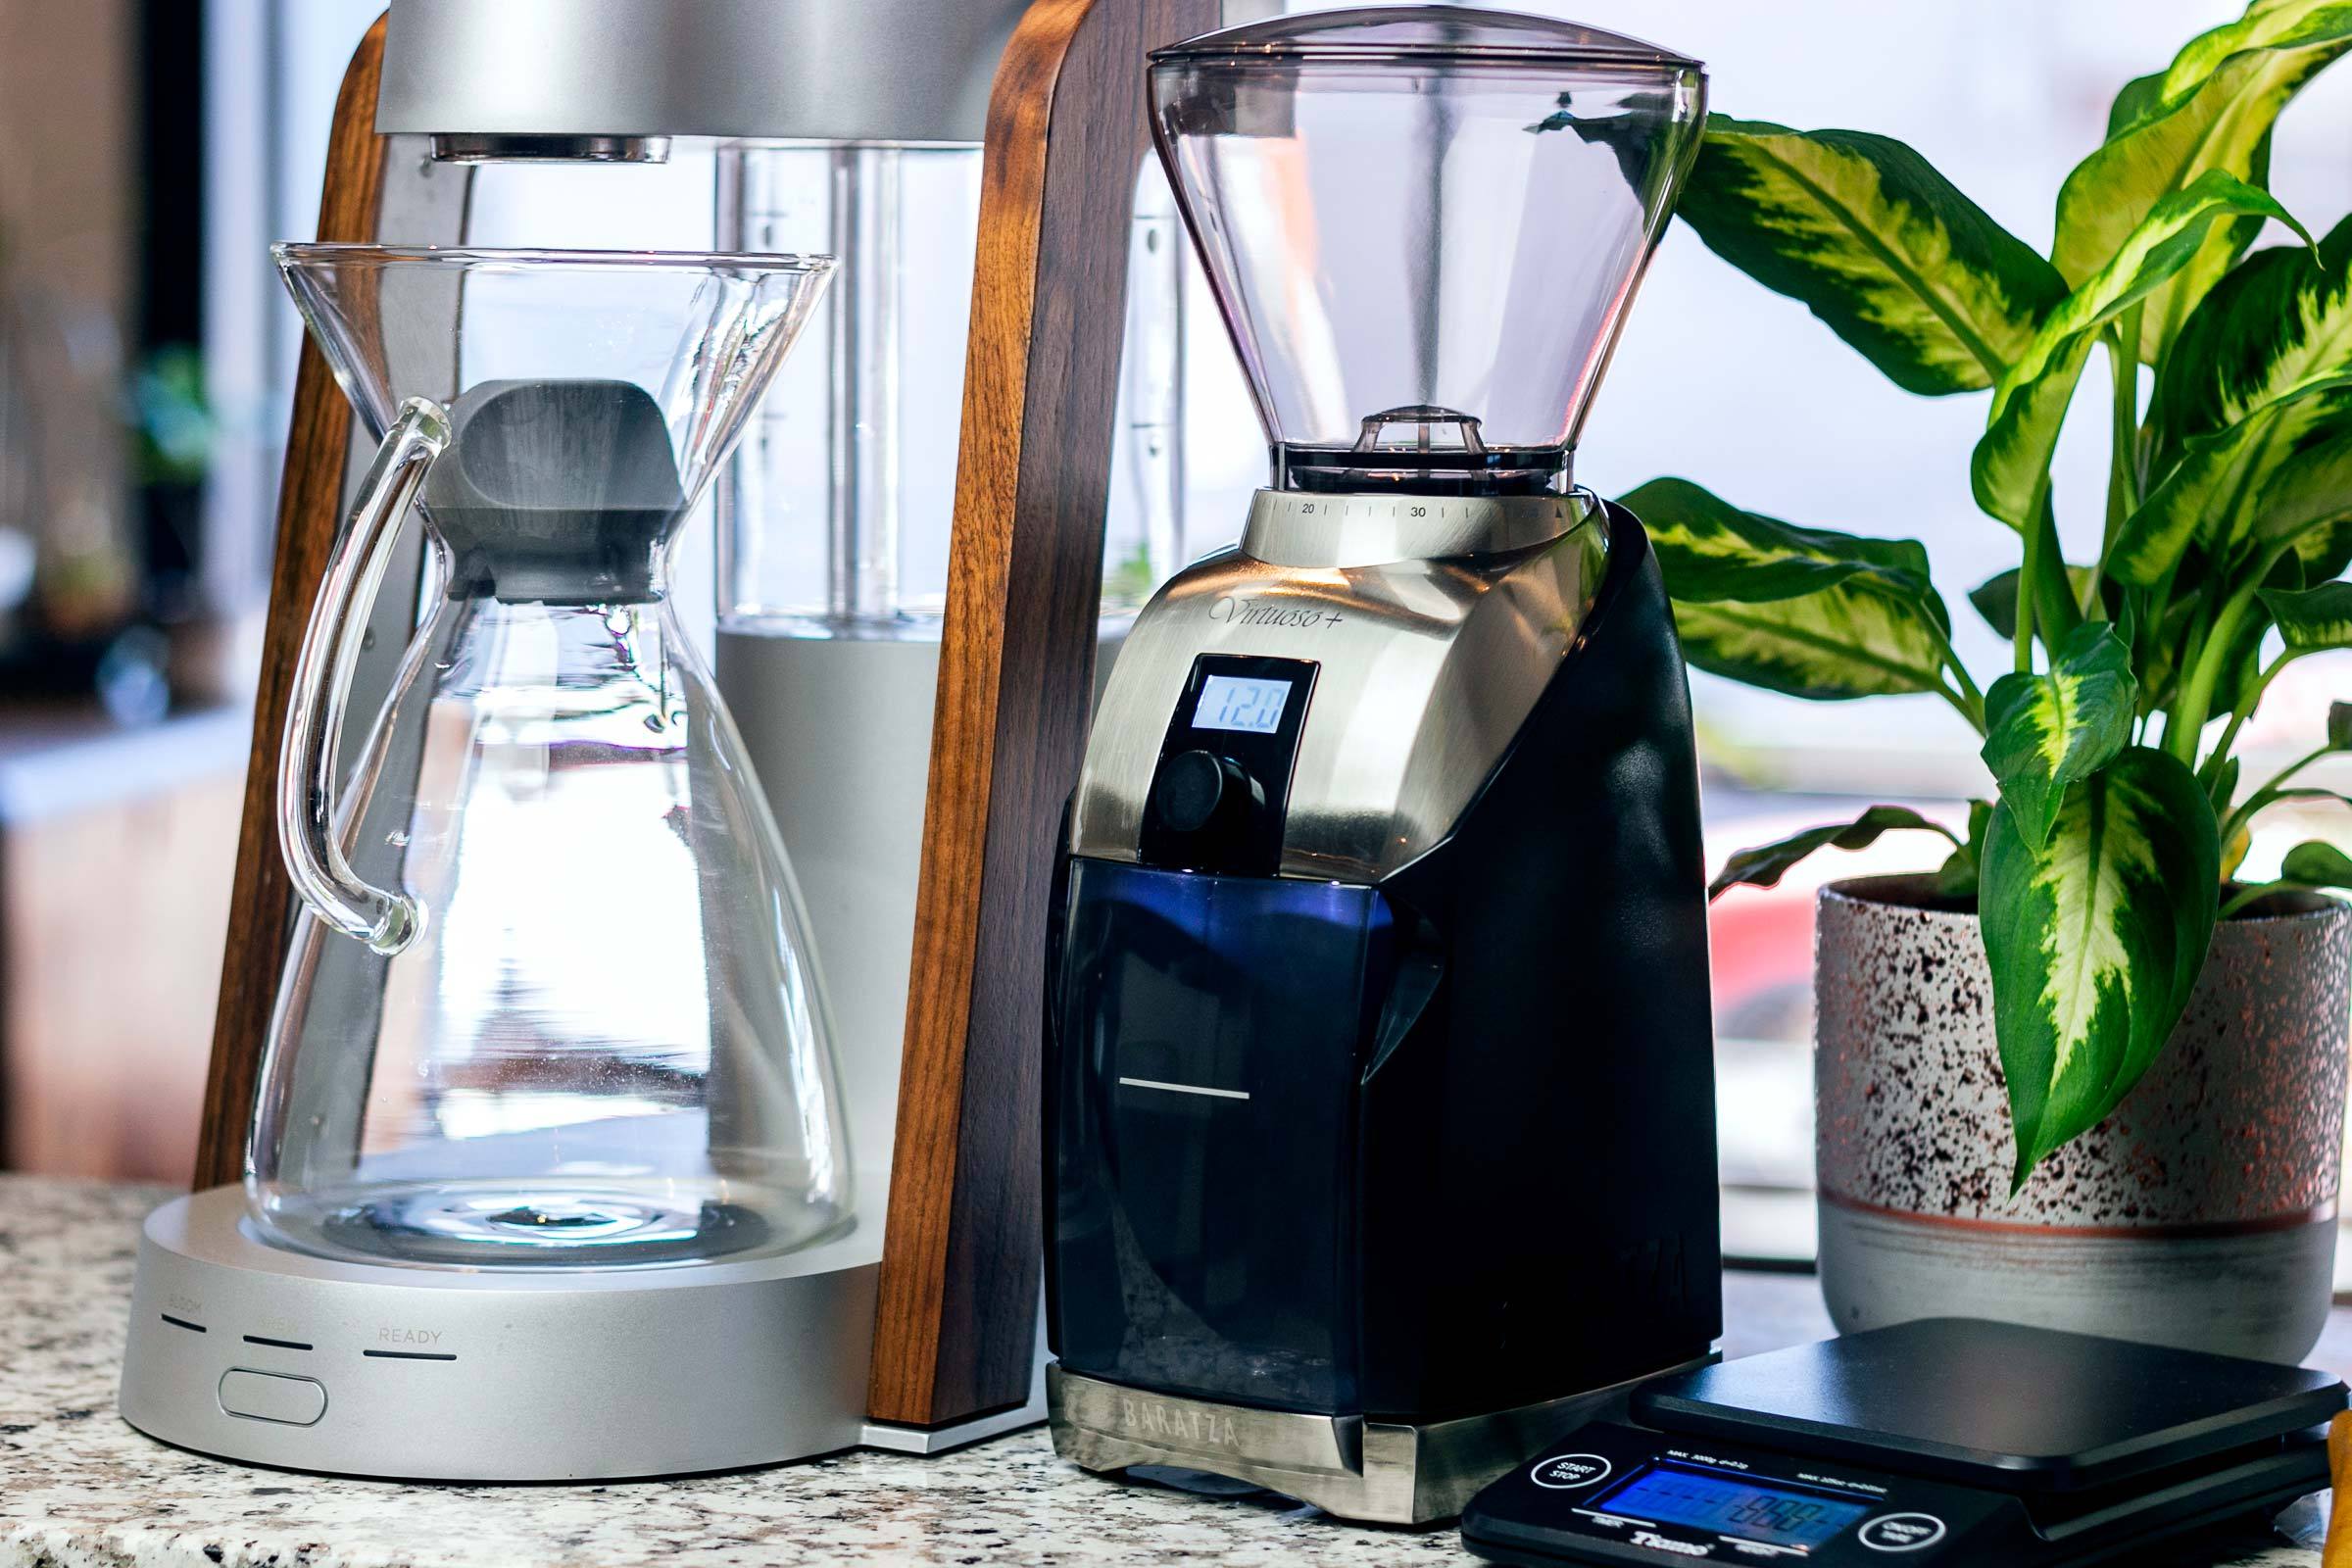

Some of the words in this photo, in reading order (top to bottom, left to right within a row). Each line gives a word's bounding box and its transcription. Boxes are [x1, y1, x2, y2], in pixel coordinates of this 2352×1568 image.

[1301, 503, 1315, 514] 20
[1410, 507, 1426, 517] 30
[378, 1327, 442, 1345] READY
[1122, 1397, 1241, 1447] BARATZA
[1556, 1461, 1596, 1474] START
[1548, 1470, 1581, 1480] STOP
